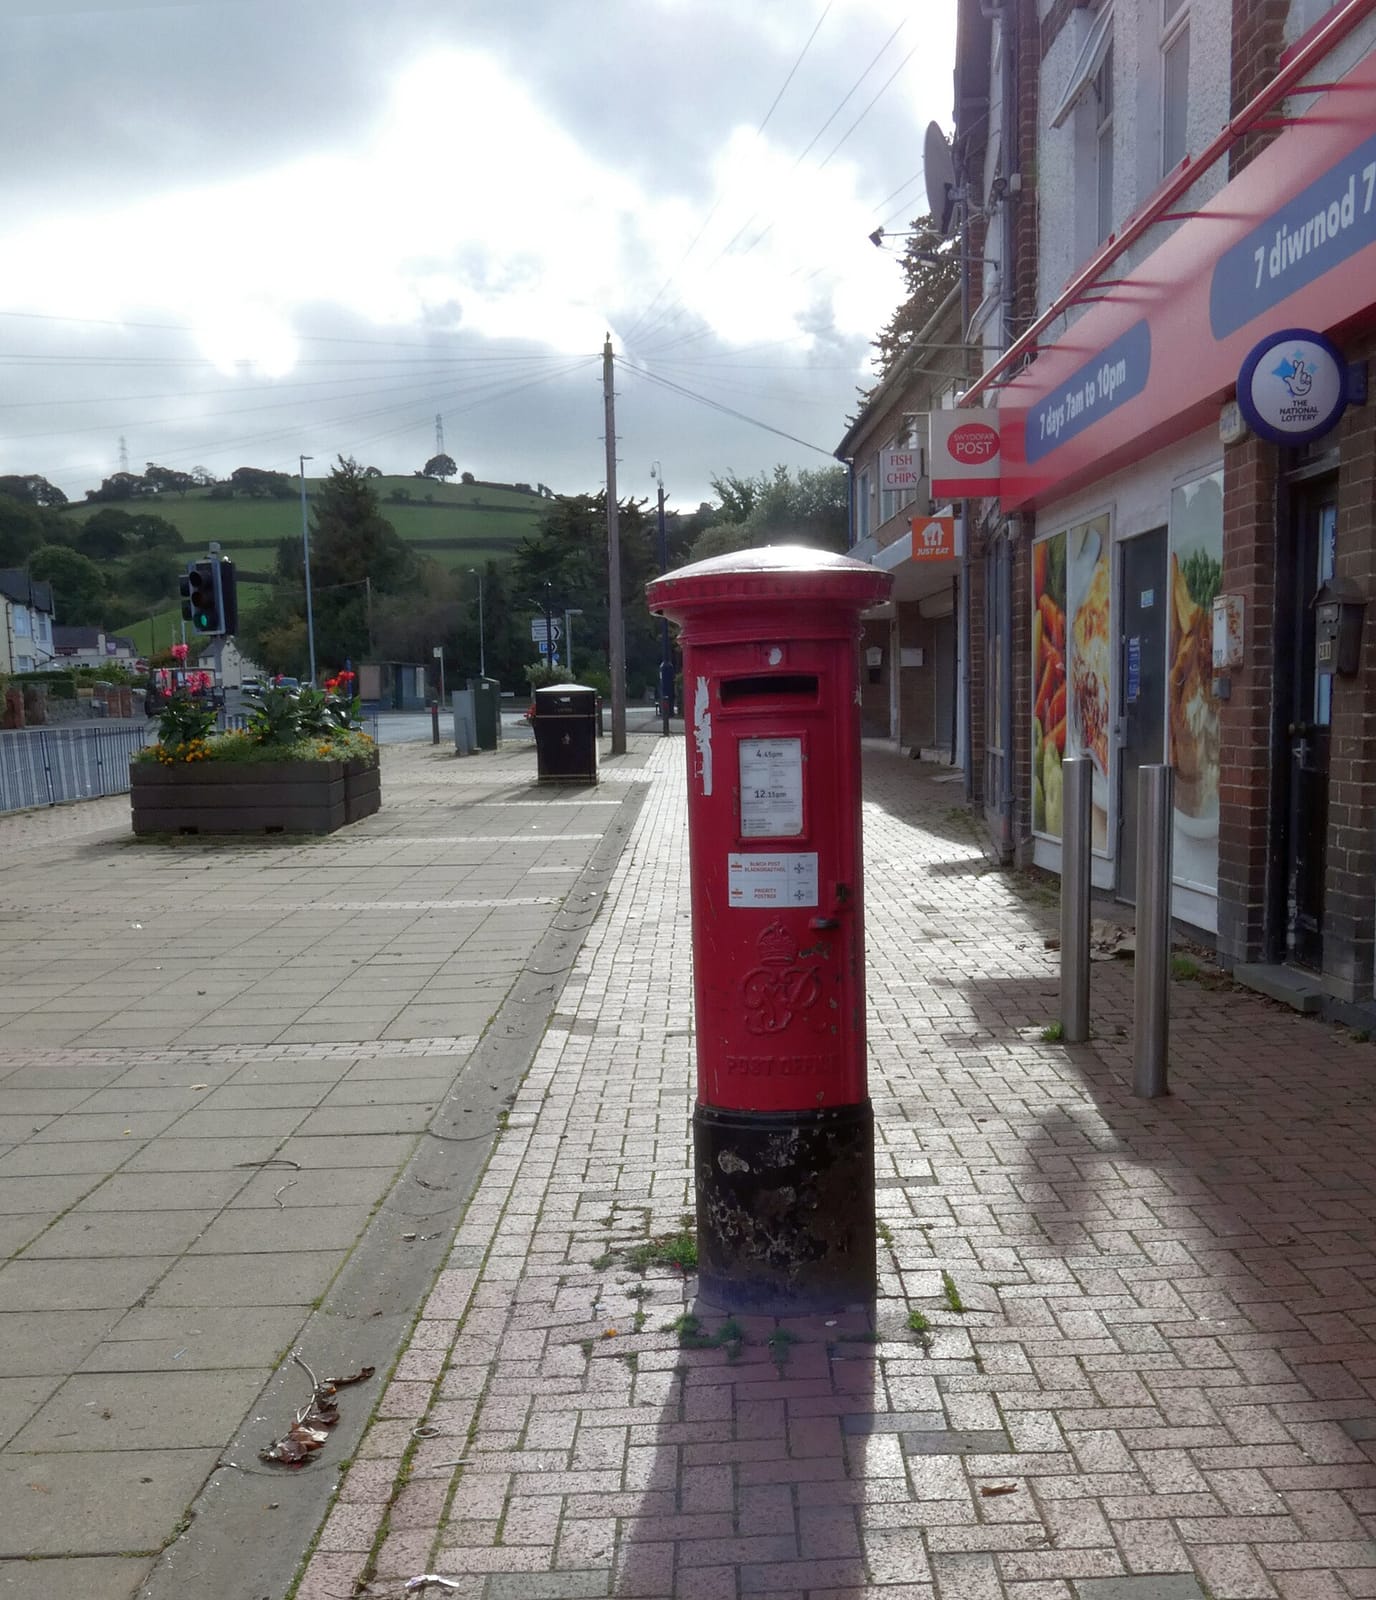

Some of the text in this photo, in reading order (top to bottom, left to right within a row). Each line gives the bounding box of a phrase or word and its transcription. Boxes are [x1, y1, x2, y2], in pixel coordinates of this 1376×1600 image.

[1254, 245, 1265, 289] 7
[1269, 174, 1355, 279] diwrnod
[1040, 358, 1126, 440] 7 days 7am to 10pm
[1292, 399, 1308, 407] THE
[1279, 405, 1320, 415] NATIONAL
[1281, 413, 1317, 423] LOTTERY
[956, 441, 993, 455] POST
[890, 454, 913, 466] FISH
[887, 472, 917, 484] CHIPS
[917, 547, 950, 556] JUST EAT
[726, 1055, 776, 1076] POST
